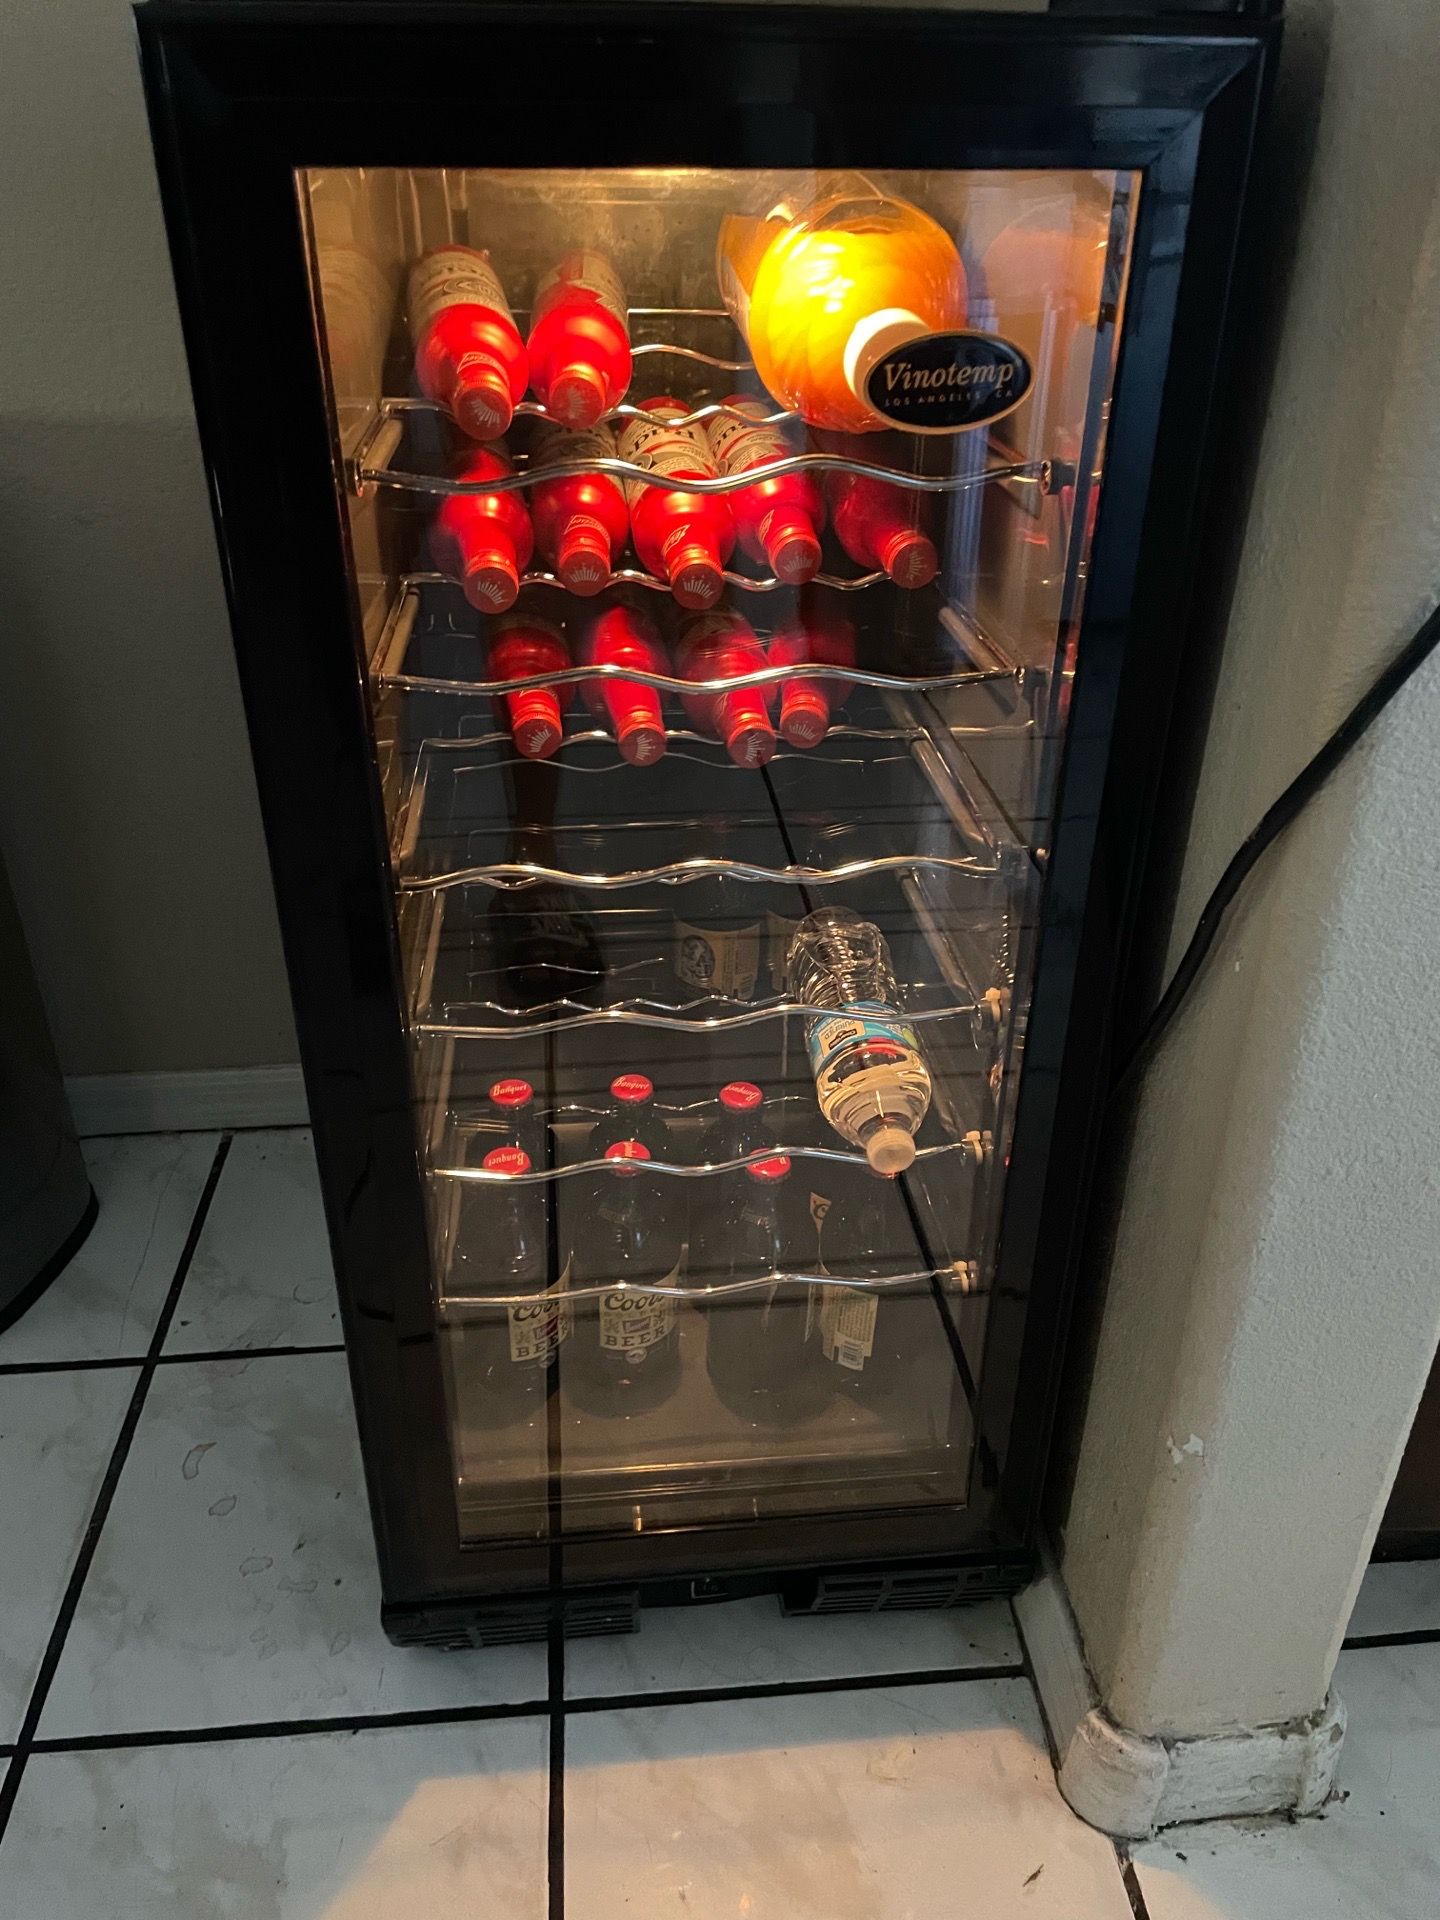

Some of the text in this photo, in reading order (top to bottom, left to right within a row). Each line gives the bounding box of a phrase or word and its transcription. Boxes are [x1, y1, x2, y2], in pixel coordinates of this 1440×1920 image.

[884, 362, 1014, 391] Vinotemp
[885, 397, 910, 407] LOS
[492, 1084, 528, 1096] Banquet
[612, 1076, 650, 1090] Banquet
[488, 1152, 524, 1167] Banquet
[604, 1326, 665, 1347] BEER
